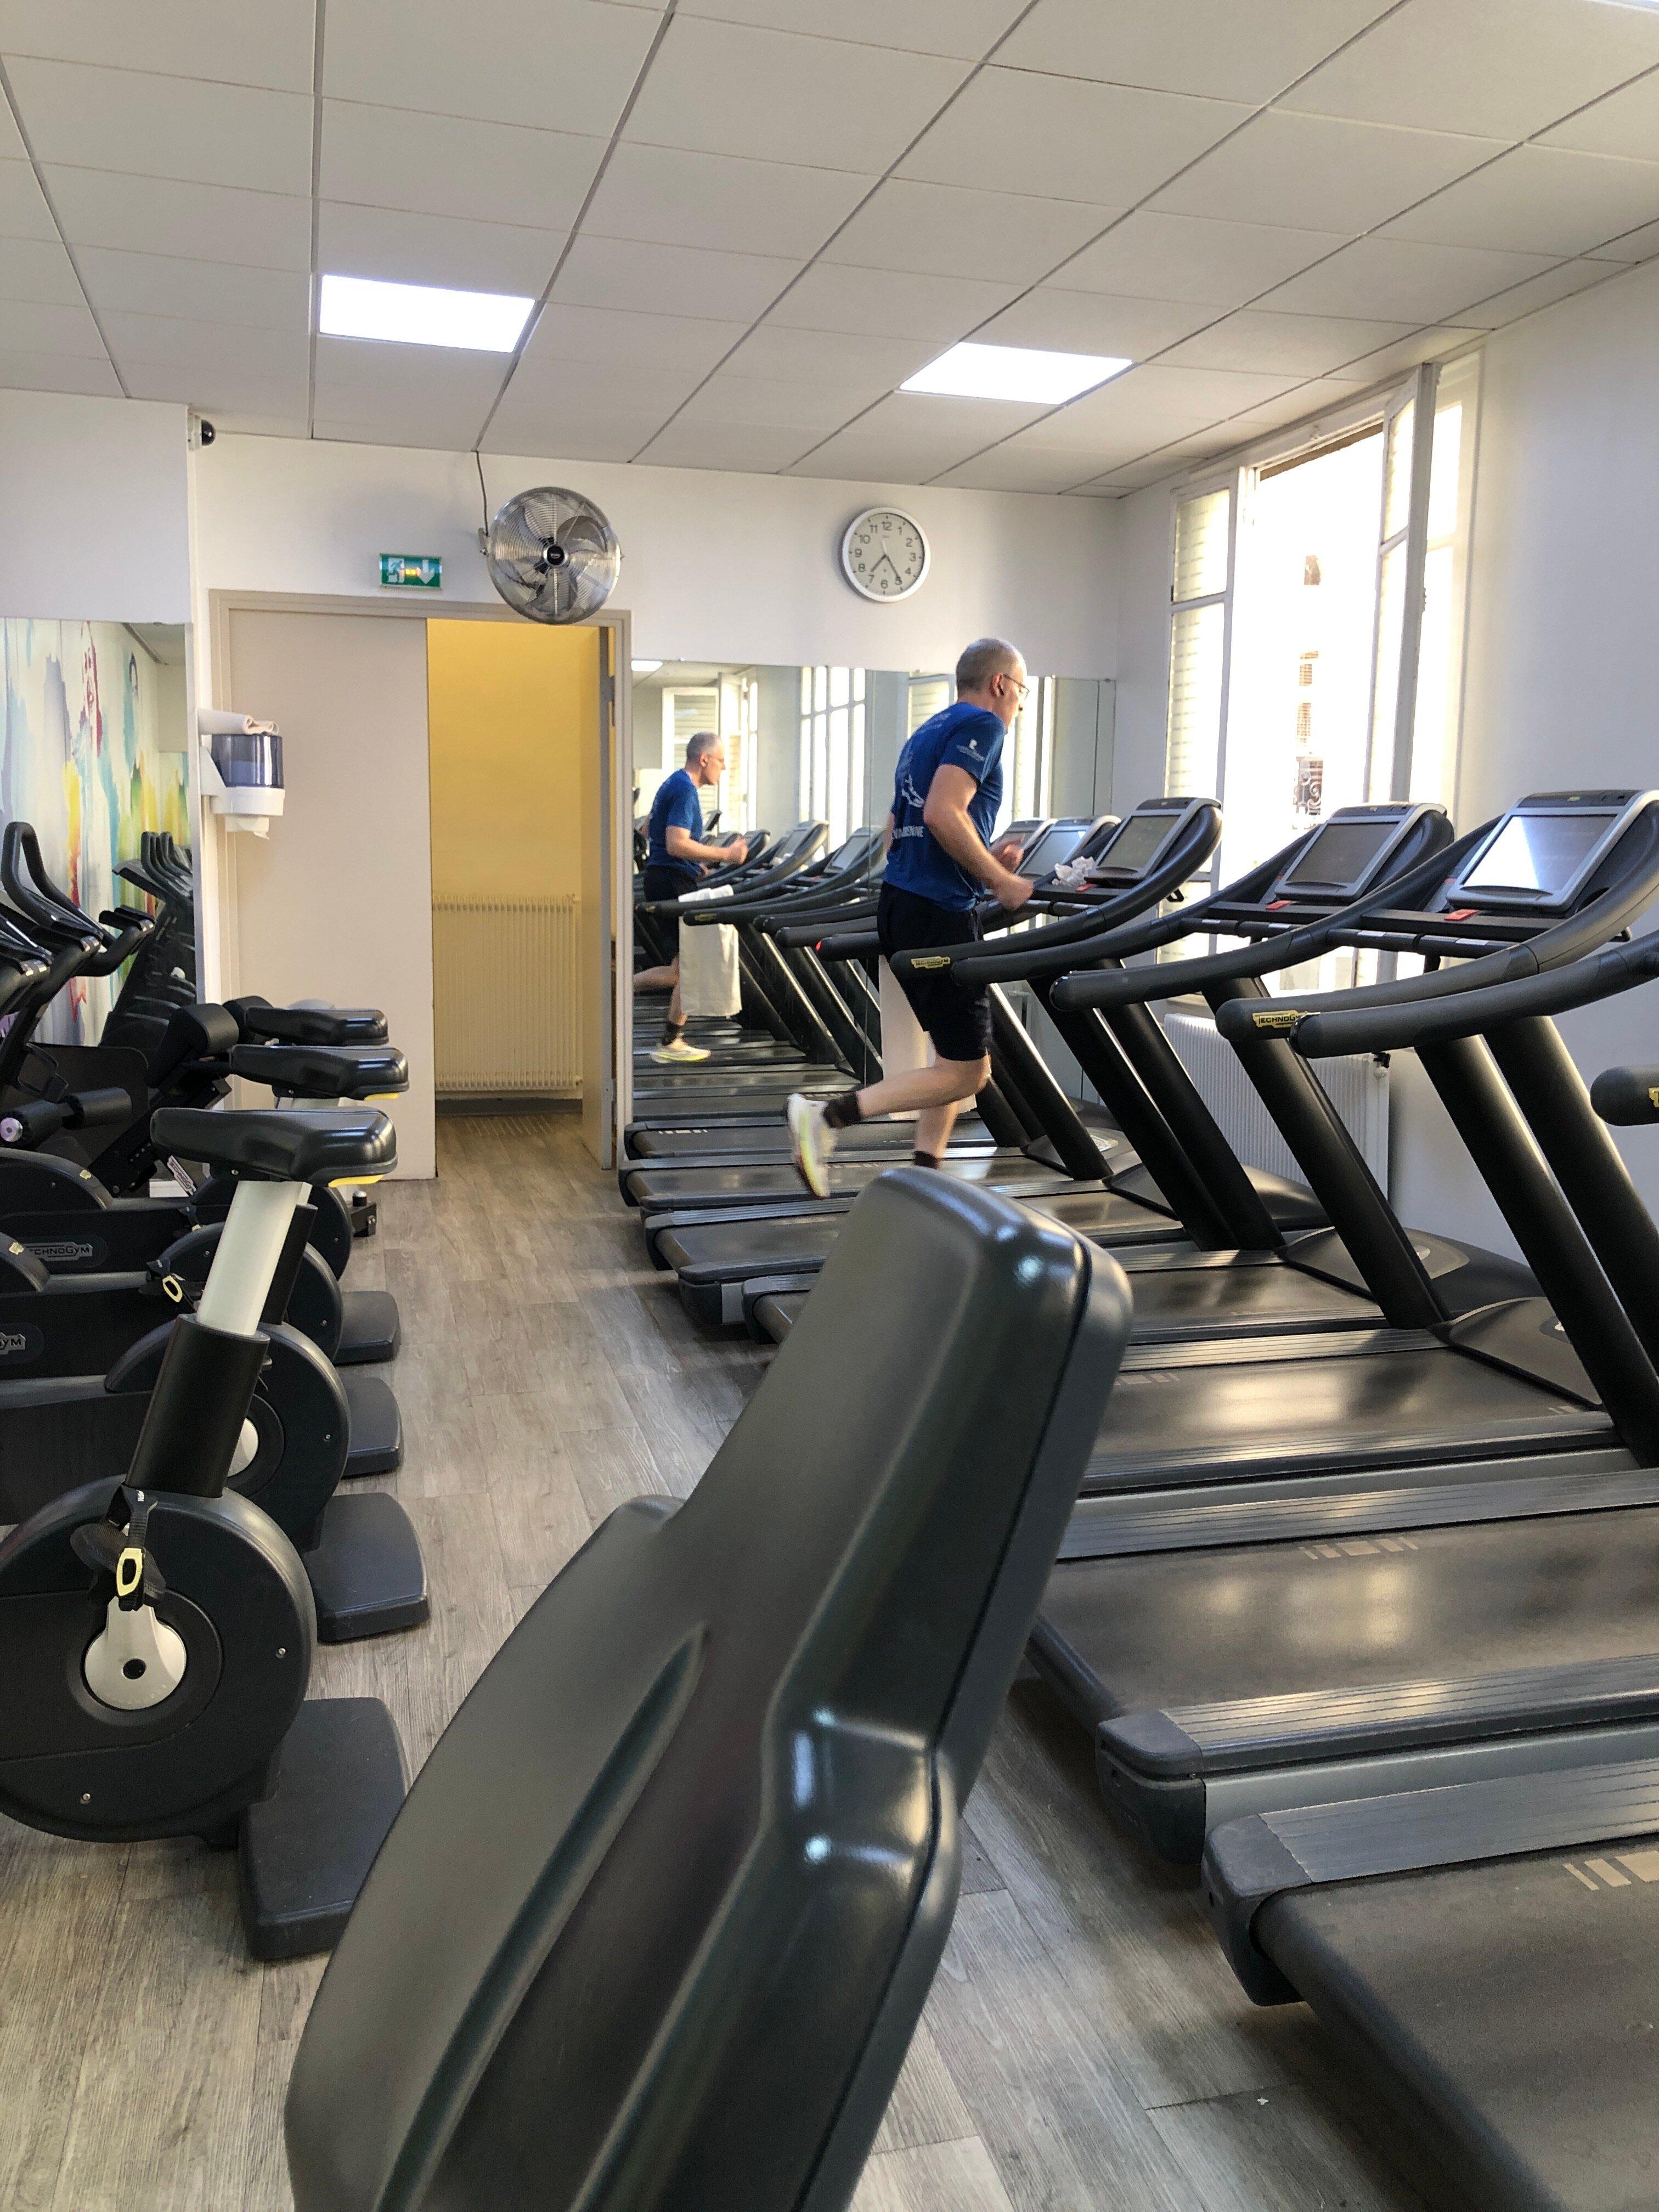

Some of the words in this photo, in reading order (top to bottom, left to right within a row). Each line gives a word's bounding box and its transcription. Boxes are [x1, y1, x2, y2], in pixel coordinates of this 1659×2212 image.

[870, 525, 878, 533] 11
[882, 521, 892, 531] 12
[898, 527, 902, 535] 1
[858, 534, 871, 544] 10
[906, 538, 913, 548] 2
[854, 549, 862, 558] 9
[910, 552, 917, 562] 3
[858, 563, 866, 573] 8
[868, 574, 874, 584] 7
[881, 580, 889, 589] 6
